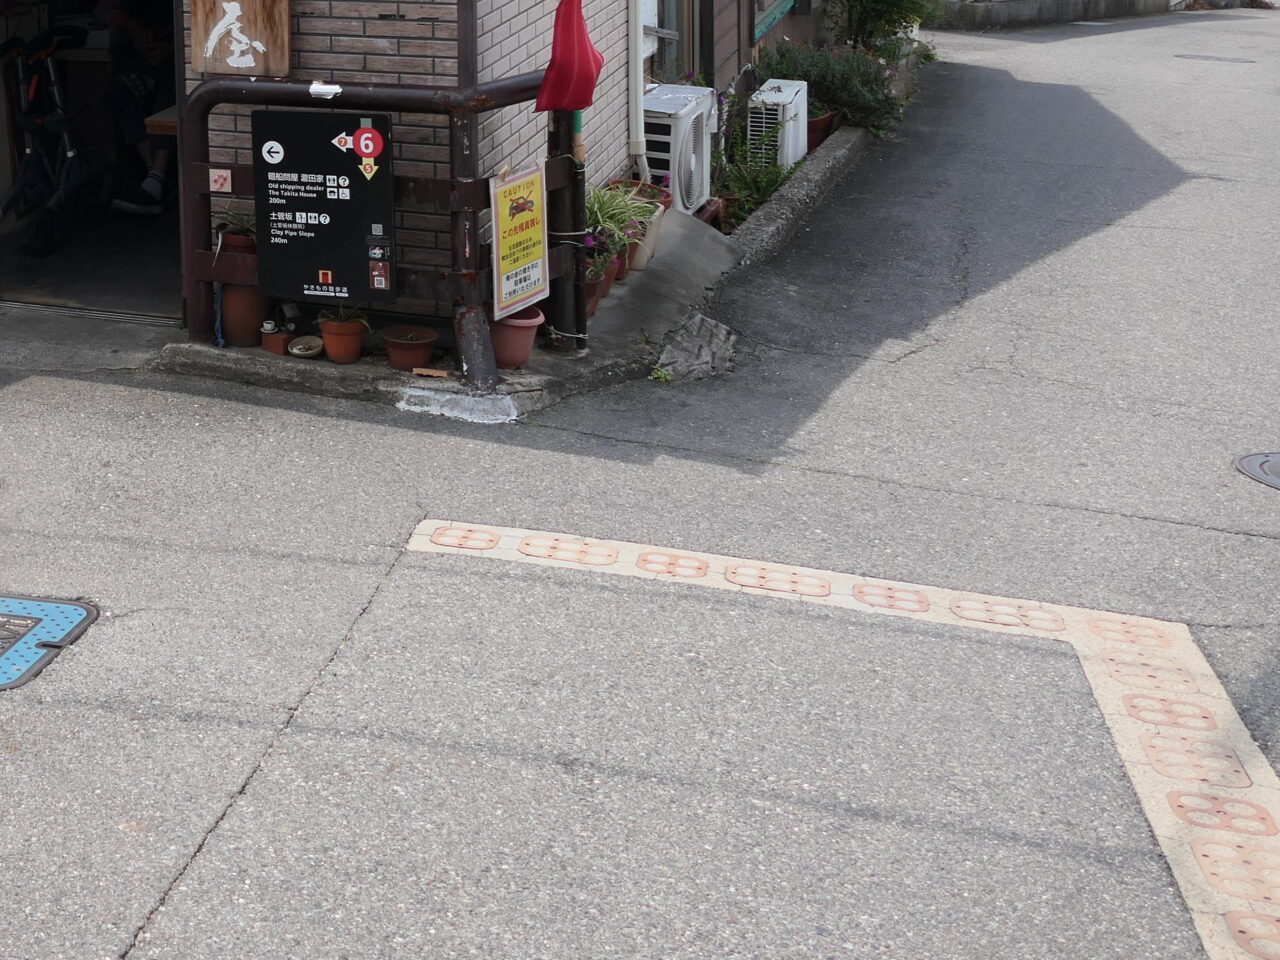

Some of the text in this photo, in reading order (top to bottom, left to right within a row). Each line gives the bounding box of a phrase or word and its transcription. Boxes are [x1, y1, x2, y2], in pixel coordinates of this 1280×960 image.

[360, 133, 374, 154] 6
[503, 180, 535, 198] CAUTION
[269, 212, 293, 221] 土管坂
[271, 229, 284, 237] Clay
